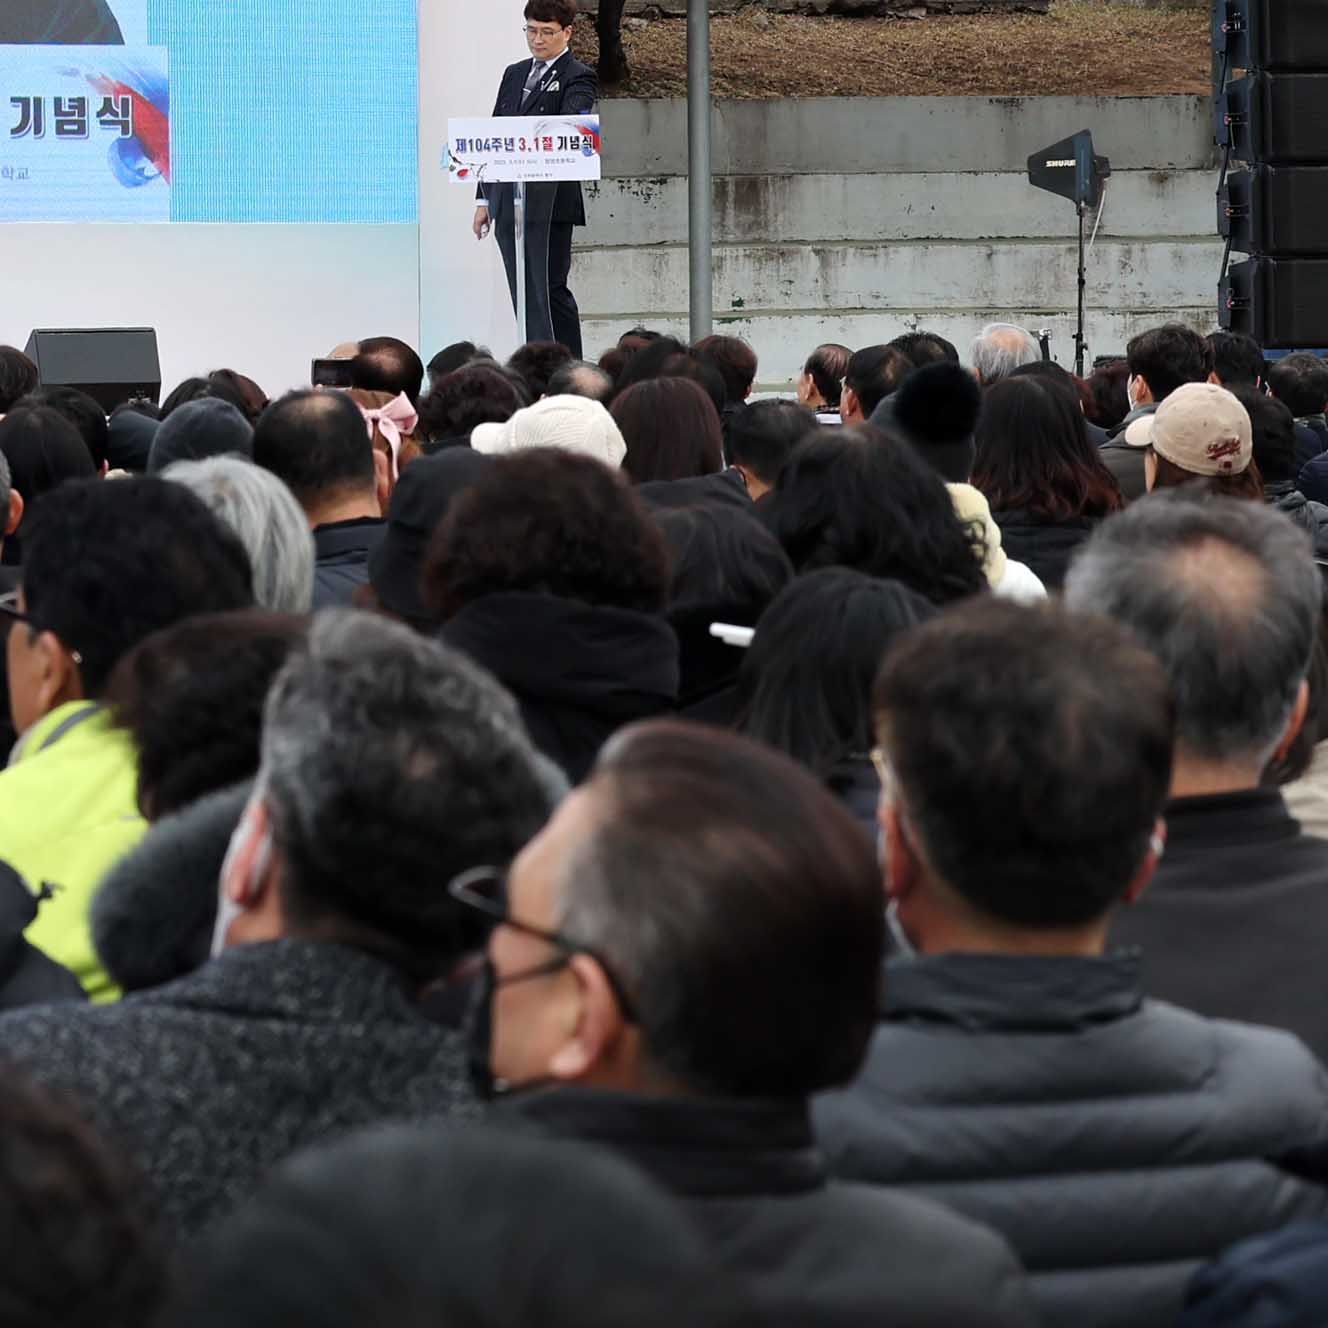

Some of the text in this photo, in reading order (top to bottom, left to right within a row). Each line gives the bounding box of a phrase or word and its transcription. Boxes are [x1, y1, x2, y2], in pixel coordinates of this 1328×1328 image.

[10, 95, 135, 139] 기념식
[456, 135, 594, 153] 제104주년 3.1절 기념식
[1046, 159, 1076, 167] SHURE
